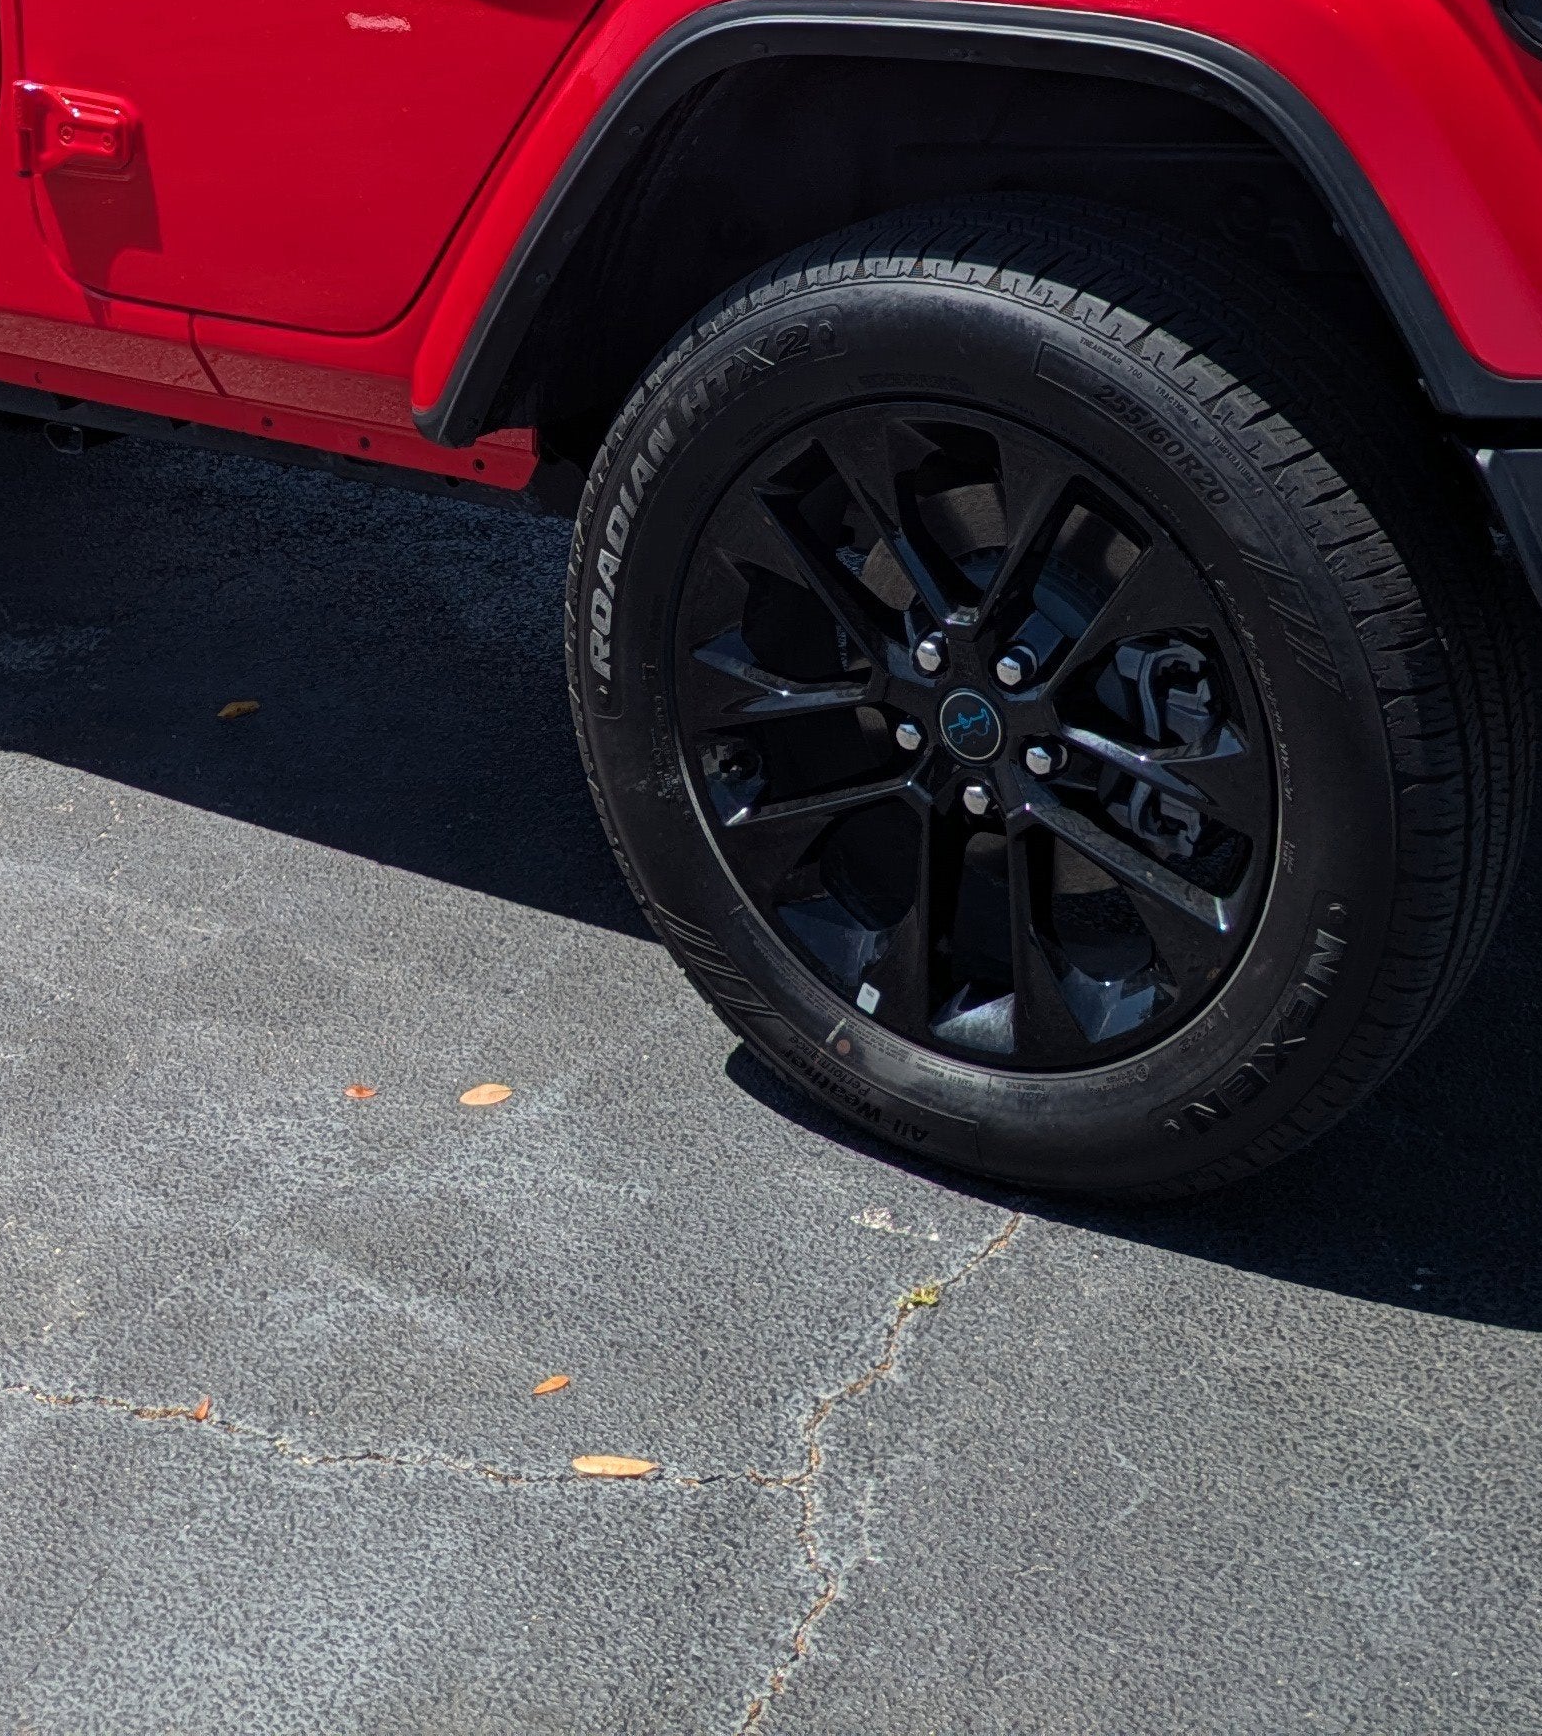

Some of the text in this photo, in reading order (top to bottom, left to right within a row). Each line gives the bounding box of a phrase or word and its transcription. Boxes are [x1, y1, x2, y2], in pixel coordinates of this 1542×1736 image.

[1079, 336, 1124, 366] TREADWEAR
[1127, 365, 1143, 380] 700
[590, 417, 678, 681] ROADIAN
[678, 324, 812, 428] HTX2
[1093, 384, 1230, 505] 255/60R20
[1180, 928, 1348, 1133] NEXEN
[781, 1048, 930, 1143] All-Weather
